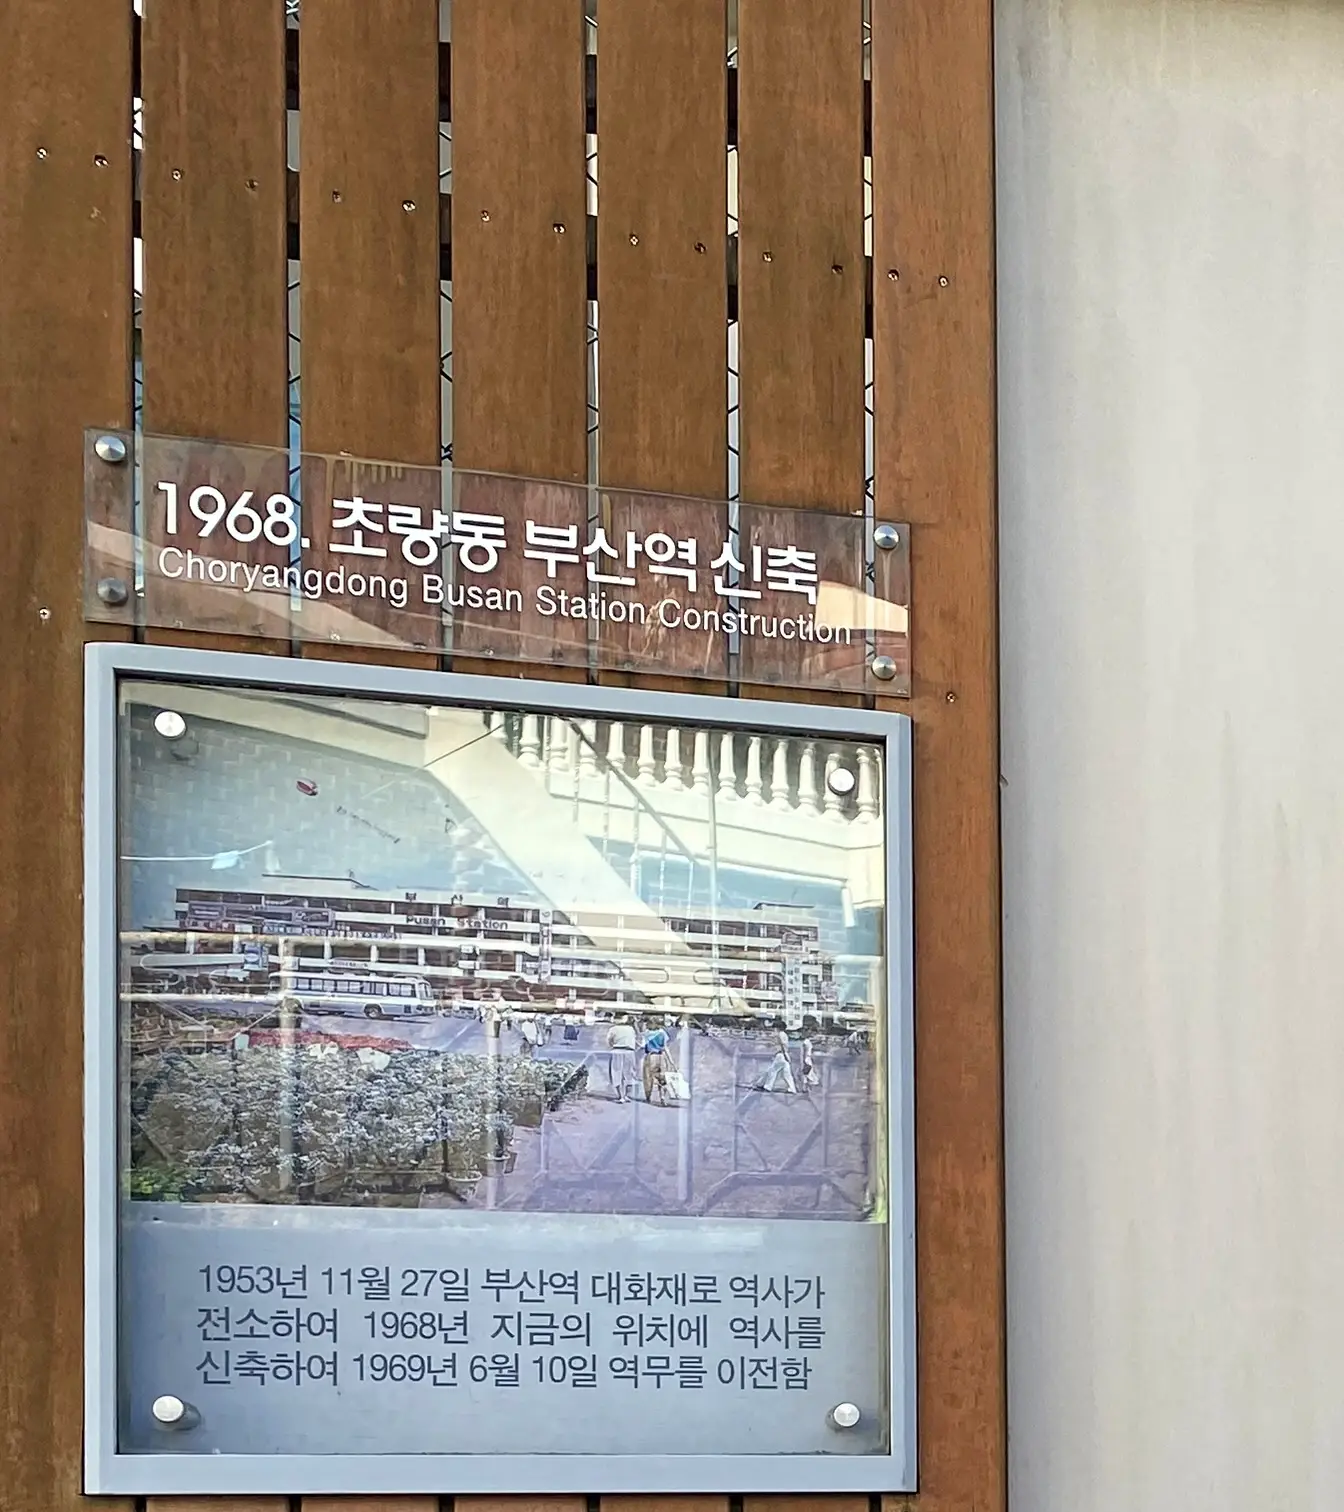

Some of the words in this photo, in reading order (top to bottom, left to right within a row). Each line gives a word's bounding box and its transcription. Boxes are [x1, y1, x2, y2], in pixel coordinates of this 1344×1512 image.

[155, 478, 312, 551] 1968.
[328, 495, 508, 575] 초량동
[524, 518, 699, 594] 부산역
[707, 540, 821, 605] 신축
[157, 546, 410, 609] Choryangdong
[420, 576, 524, 613] Busan
[535, 585, 646, 626] Station
[658, 600, 853, 646] Construction
[198, 1263, 309, 1301] 1953년
[321, 1265, 392, 1302] 11월
[399, 1266, 471, 1303] 27일
[480, 1267, 579, 1306] 부산역
[590, 1270, 723, 1308] 대화재로
[728, 1272, 826, 1311] 역사가
[196, 1310, 340, 1345] 전소하여
[363, 1310, 470, 1346] 1968년
[491, 1312, 592, 1348] 지금의
[612, 1313, 709, 1349] 위치에
[728, 1314, 827, 1351] 역사를
[196, 1350, 340, 1387] 신축하여
[350, 1351, 459, 1388] 1969년
[468, 1352, 521, 1388] 6월
[531, 1353, 599, 1388] 10일
[607, 1354, 709, 1390] 역무를
[716, 1355, 813, 1392] 이전함
